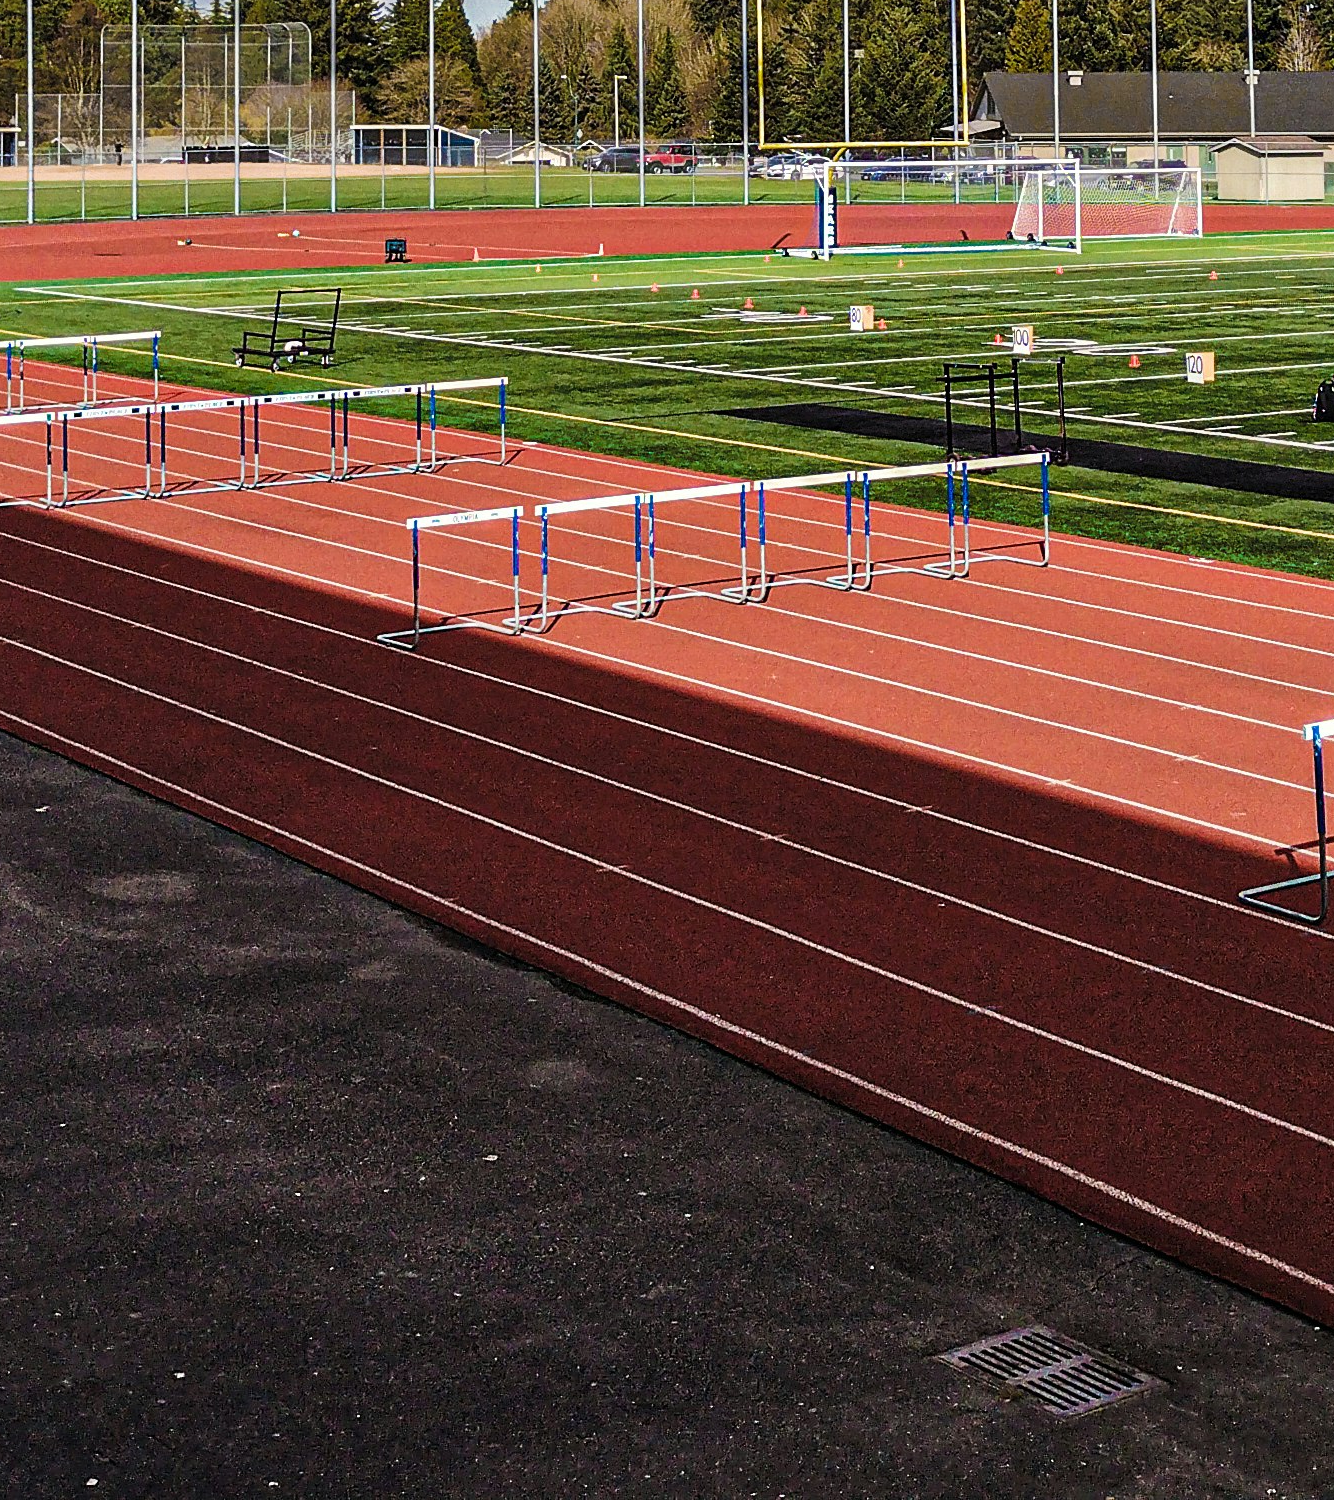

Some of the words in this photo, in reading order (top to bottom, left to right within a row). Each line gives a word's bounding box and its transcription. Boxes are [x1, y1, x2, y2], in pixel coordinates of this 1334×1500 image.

[851, 307, 862, 323] 80
[1013, 328, 1029, 346] 100
[1187, 355, 1203, 374] 120
[452, 513, 479, 523] OLYMPIA
